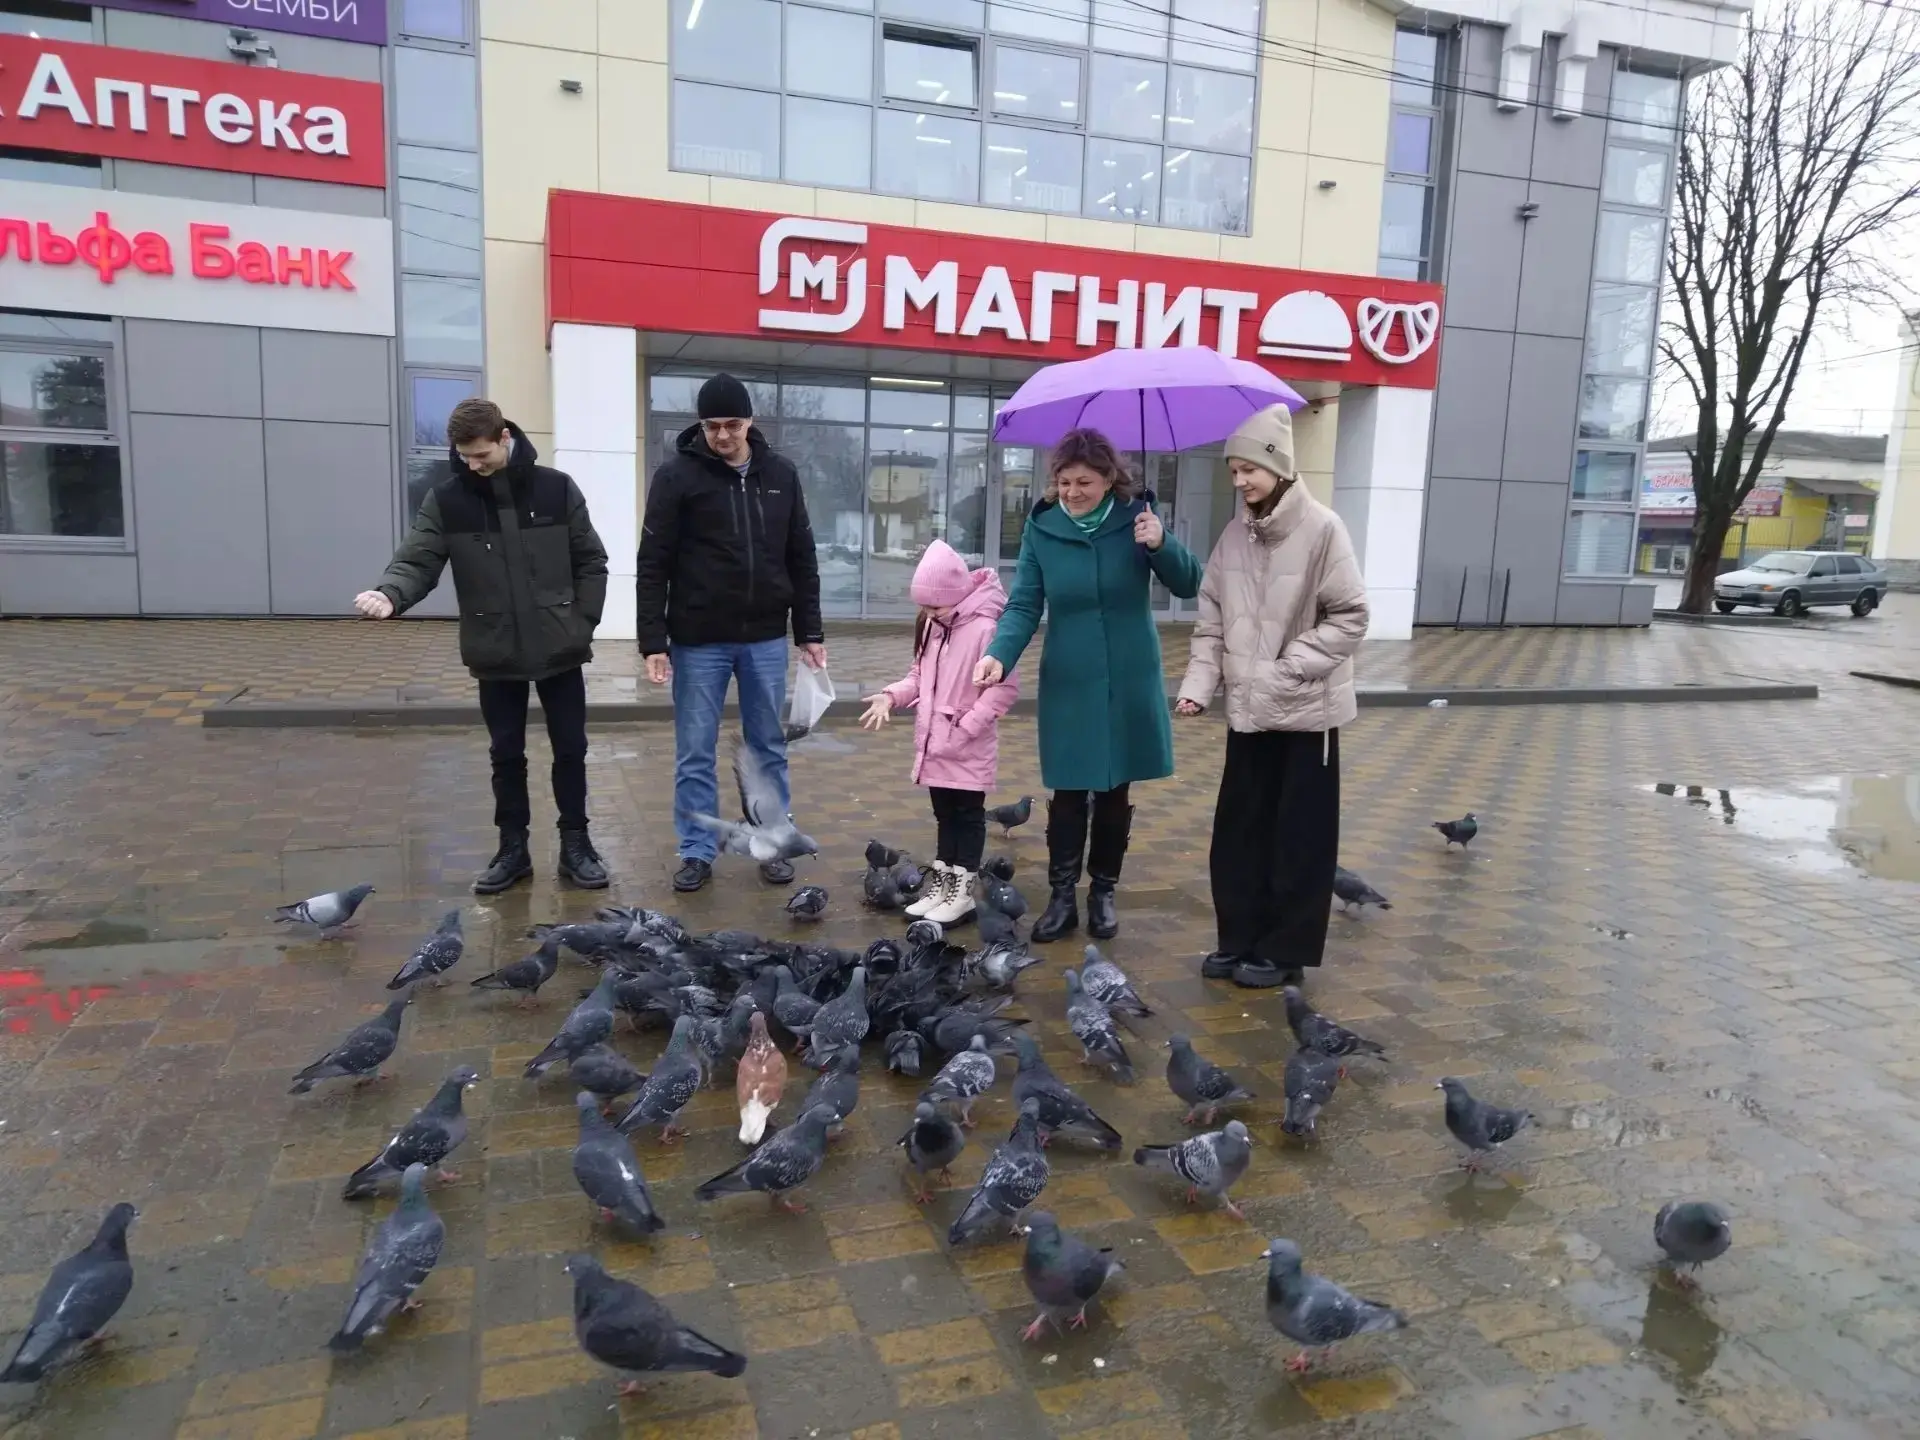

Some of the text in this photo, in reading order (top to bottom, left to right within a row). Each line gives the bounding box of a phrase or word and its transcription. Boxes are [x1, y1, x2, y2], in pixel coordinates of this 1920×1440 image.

[17, 53, 350, 156] Аптека
[189, 222, 355, 290] Банк
[883, 255, 1258, 358] МАГНИТ
